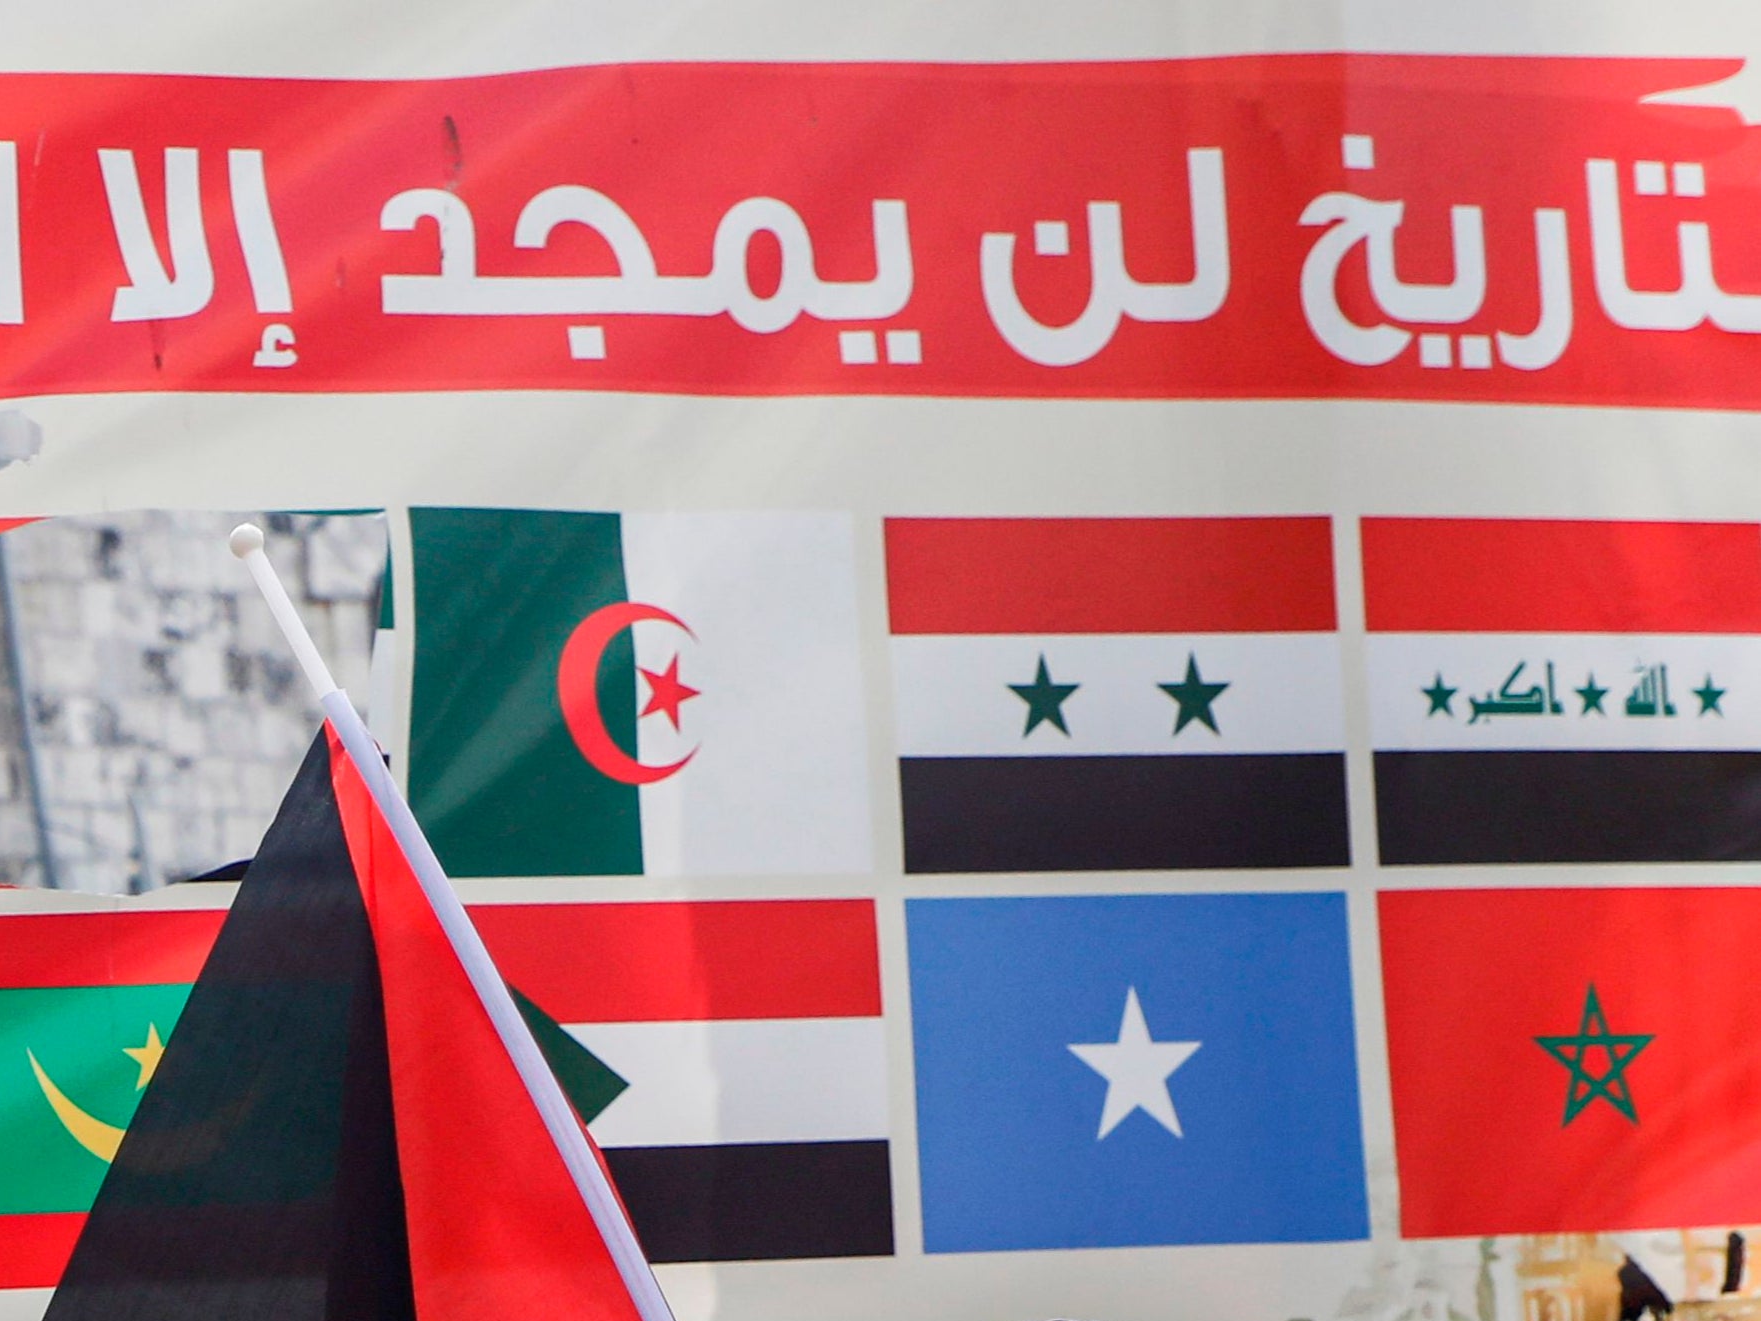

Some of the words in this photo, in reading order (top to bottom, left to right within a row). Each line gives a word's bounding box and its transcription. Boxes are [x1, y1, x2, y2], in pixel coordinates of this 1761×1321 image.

[96, 146, 298, 368] إلا
[380, 185, 914, 361] يمجد
[981, 148, 1230, 366] لن
[1298, 134, 1761, 370] تاريخ
